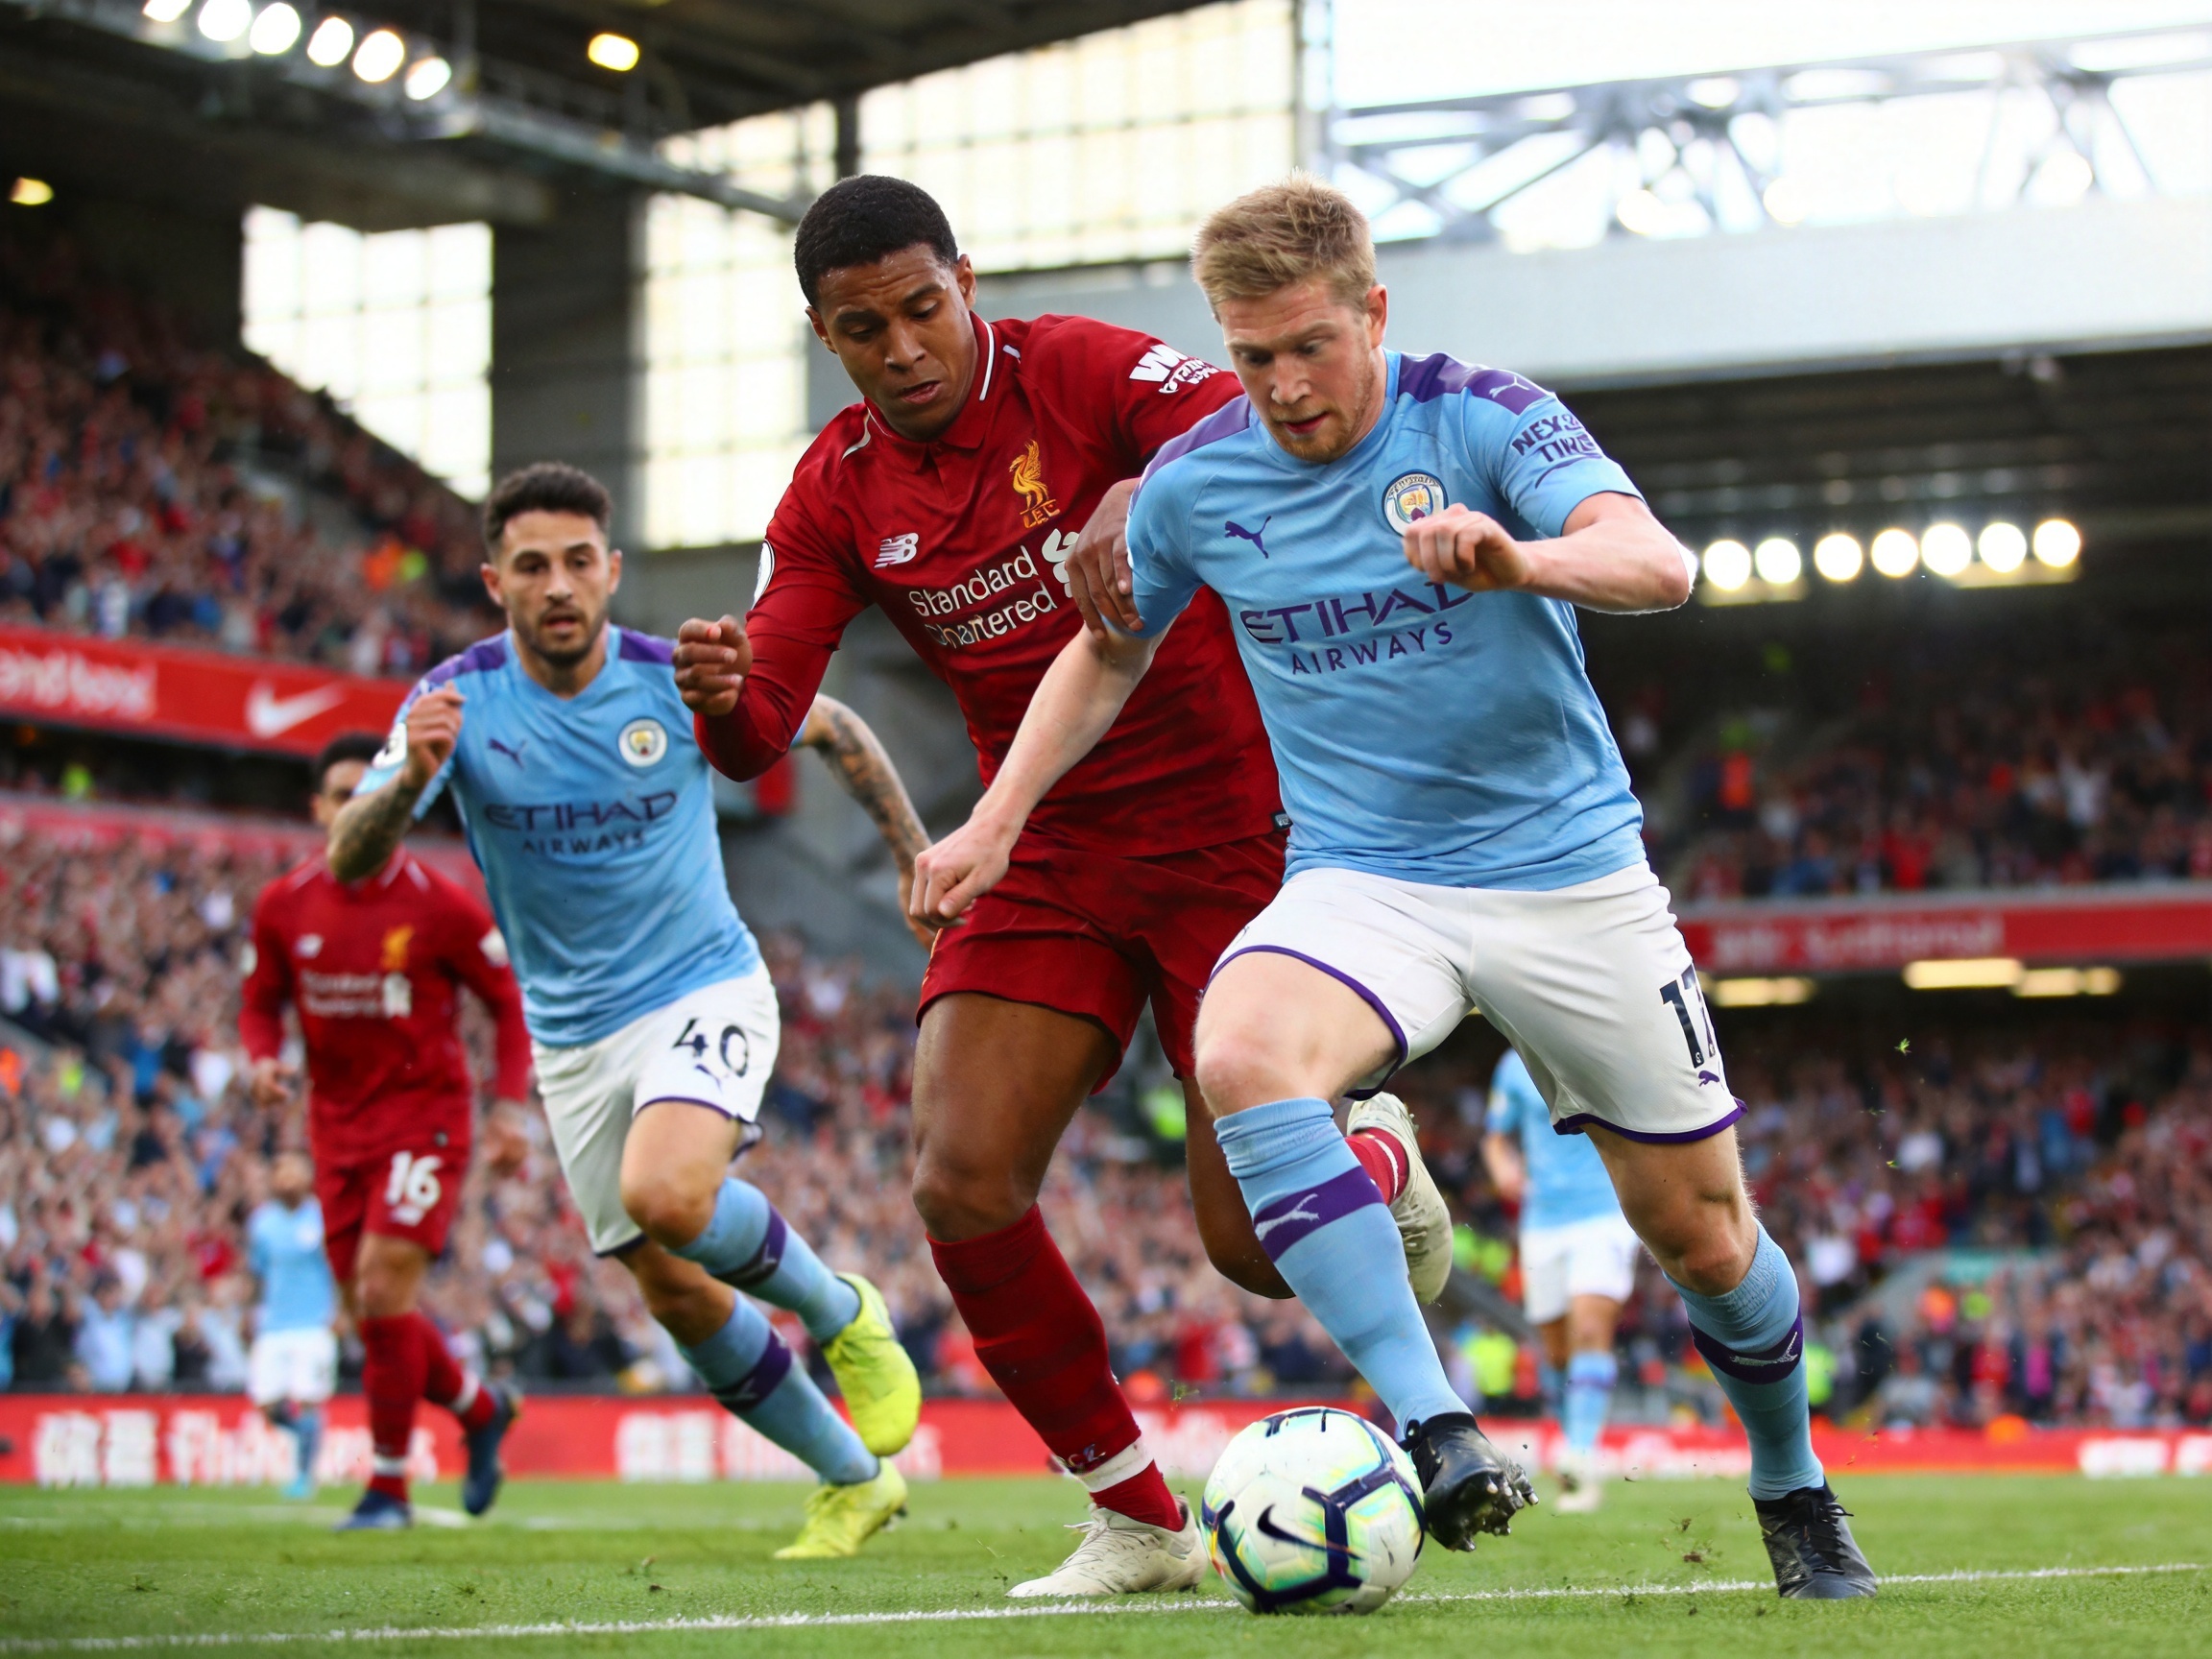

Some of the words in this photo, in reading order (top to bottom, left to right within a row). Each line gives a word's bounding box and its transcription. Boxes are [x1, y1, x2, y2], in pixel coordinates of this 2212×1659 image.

[908, 545, 1039, 617] Standard
[1291, 621, 1453, 675] AIRWAYS
[484, 790, 677, 831] ETIHAD
[522, 829, 646, 854] AIRWAYS
[672, 1018, 751, 1078] 40
[386, 1150, 444, 1211] 16
